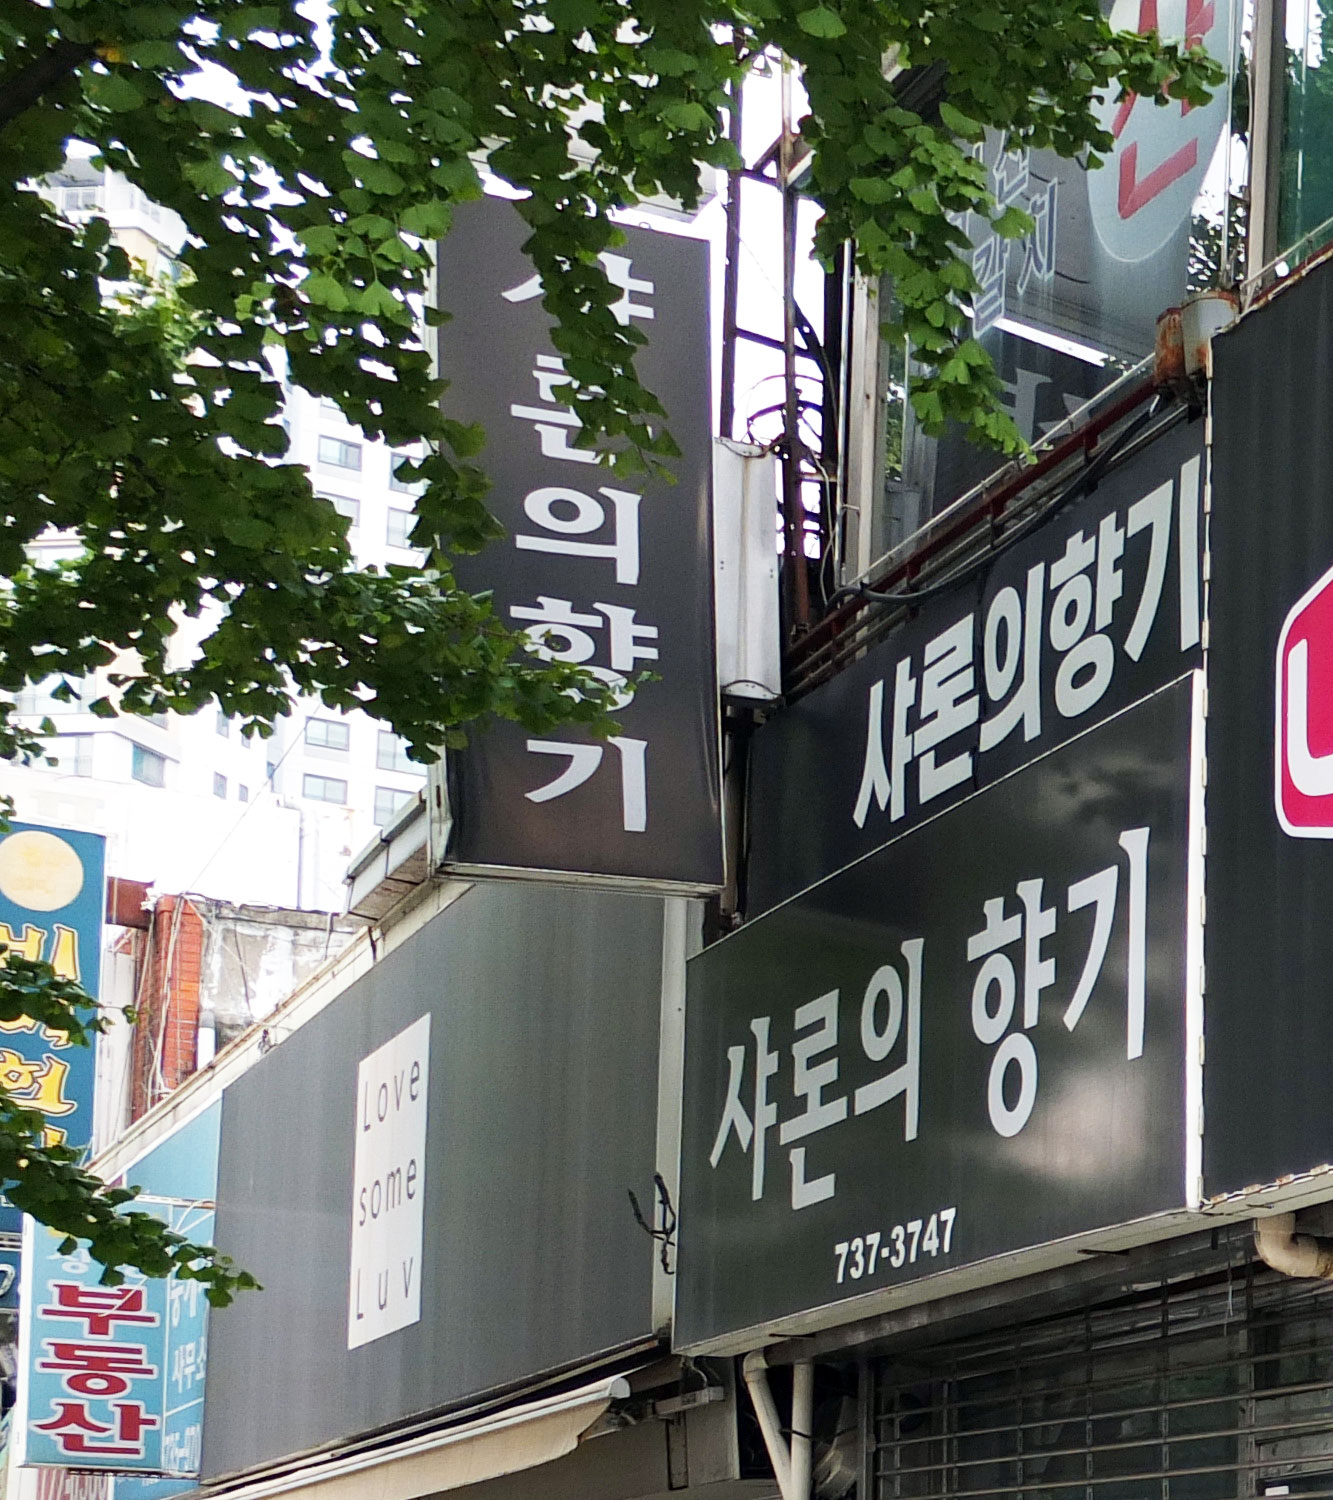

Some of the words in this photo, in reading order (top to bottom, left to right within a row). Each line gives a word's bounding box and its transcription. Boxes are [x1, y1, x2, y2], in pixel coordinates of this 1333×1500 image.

[853, 454, 1201, 829] 샤론의향기
[709, 937, 925, 1210] 샤론의
[966, 826, 1150, 1138] 향기
[363, 1058, 421, 1133] Love
[358, 1155, 418, 1227] some
[833, 1206, 957, 1285] 737-3747
[32, 1281, 159, 1458] 부동산
